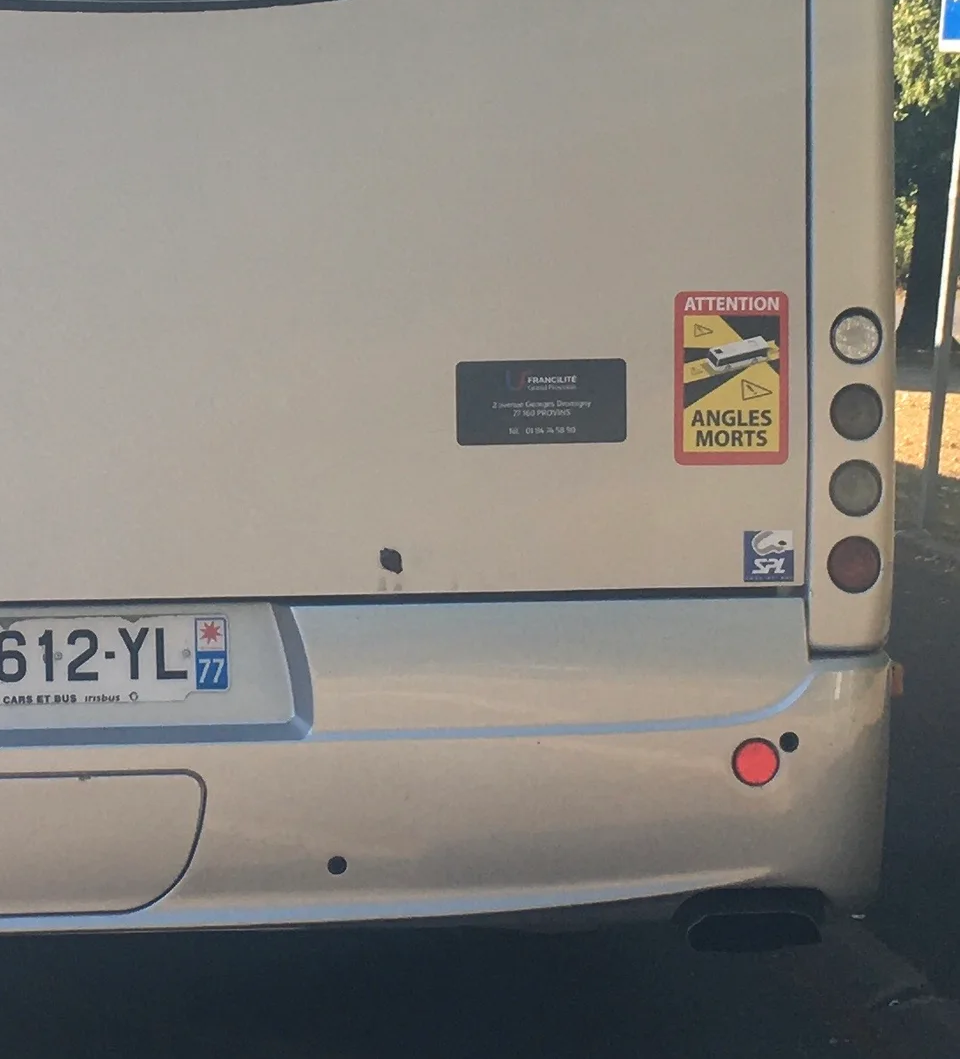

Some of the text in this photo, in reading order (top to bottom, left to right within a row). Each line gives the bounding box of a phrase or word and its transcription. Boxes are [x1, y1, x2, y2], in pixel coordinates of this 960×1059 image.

[684, 296, 780, 312] ATTENTION
[691, 409, 773, 427] ANGLES
[695, 430, 768, 448] MORTS
[198, 658, 225, 684] 77
[2, 695, 33, 705] CARS
[36, 694, 51, 704] ET
[53, 694, 77, 703] BUS
